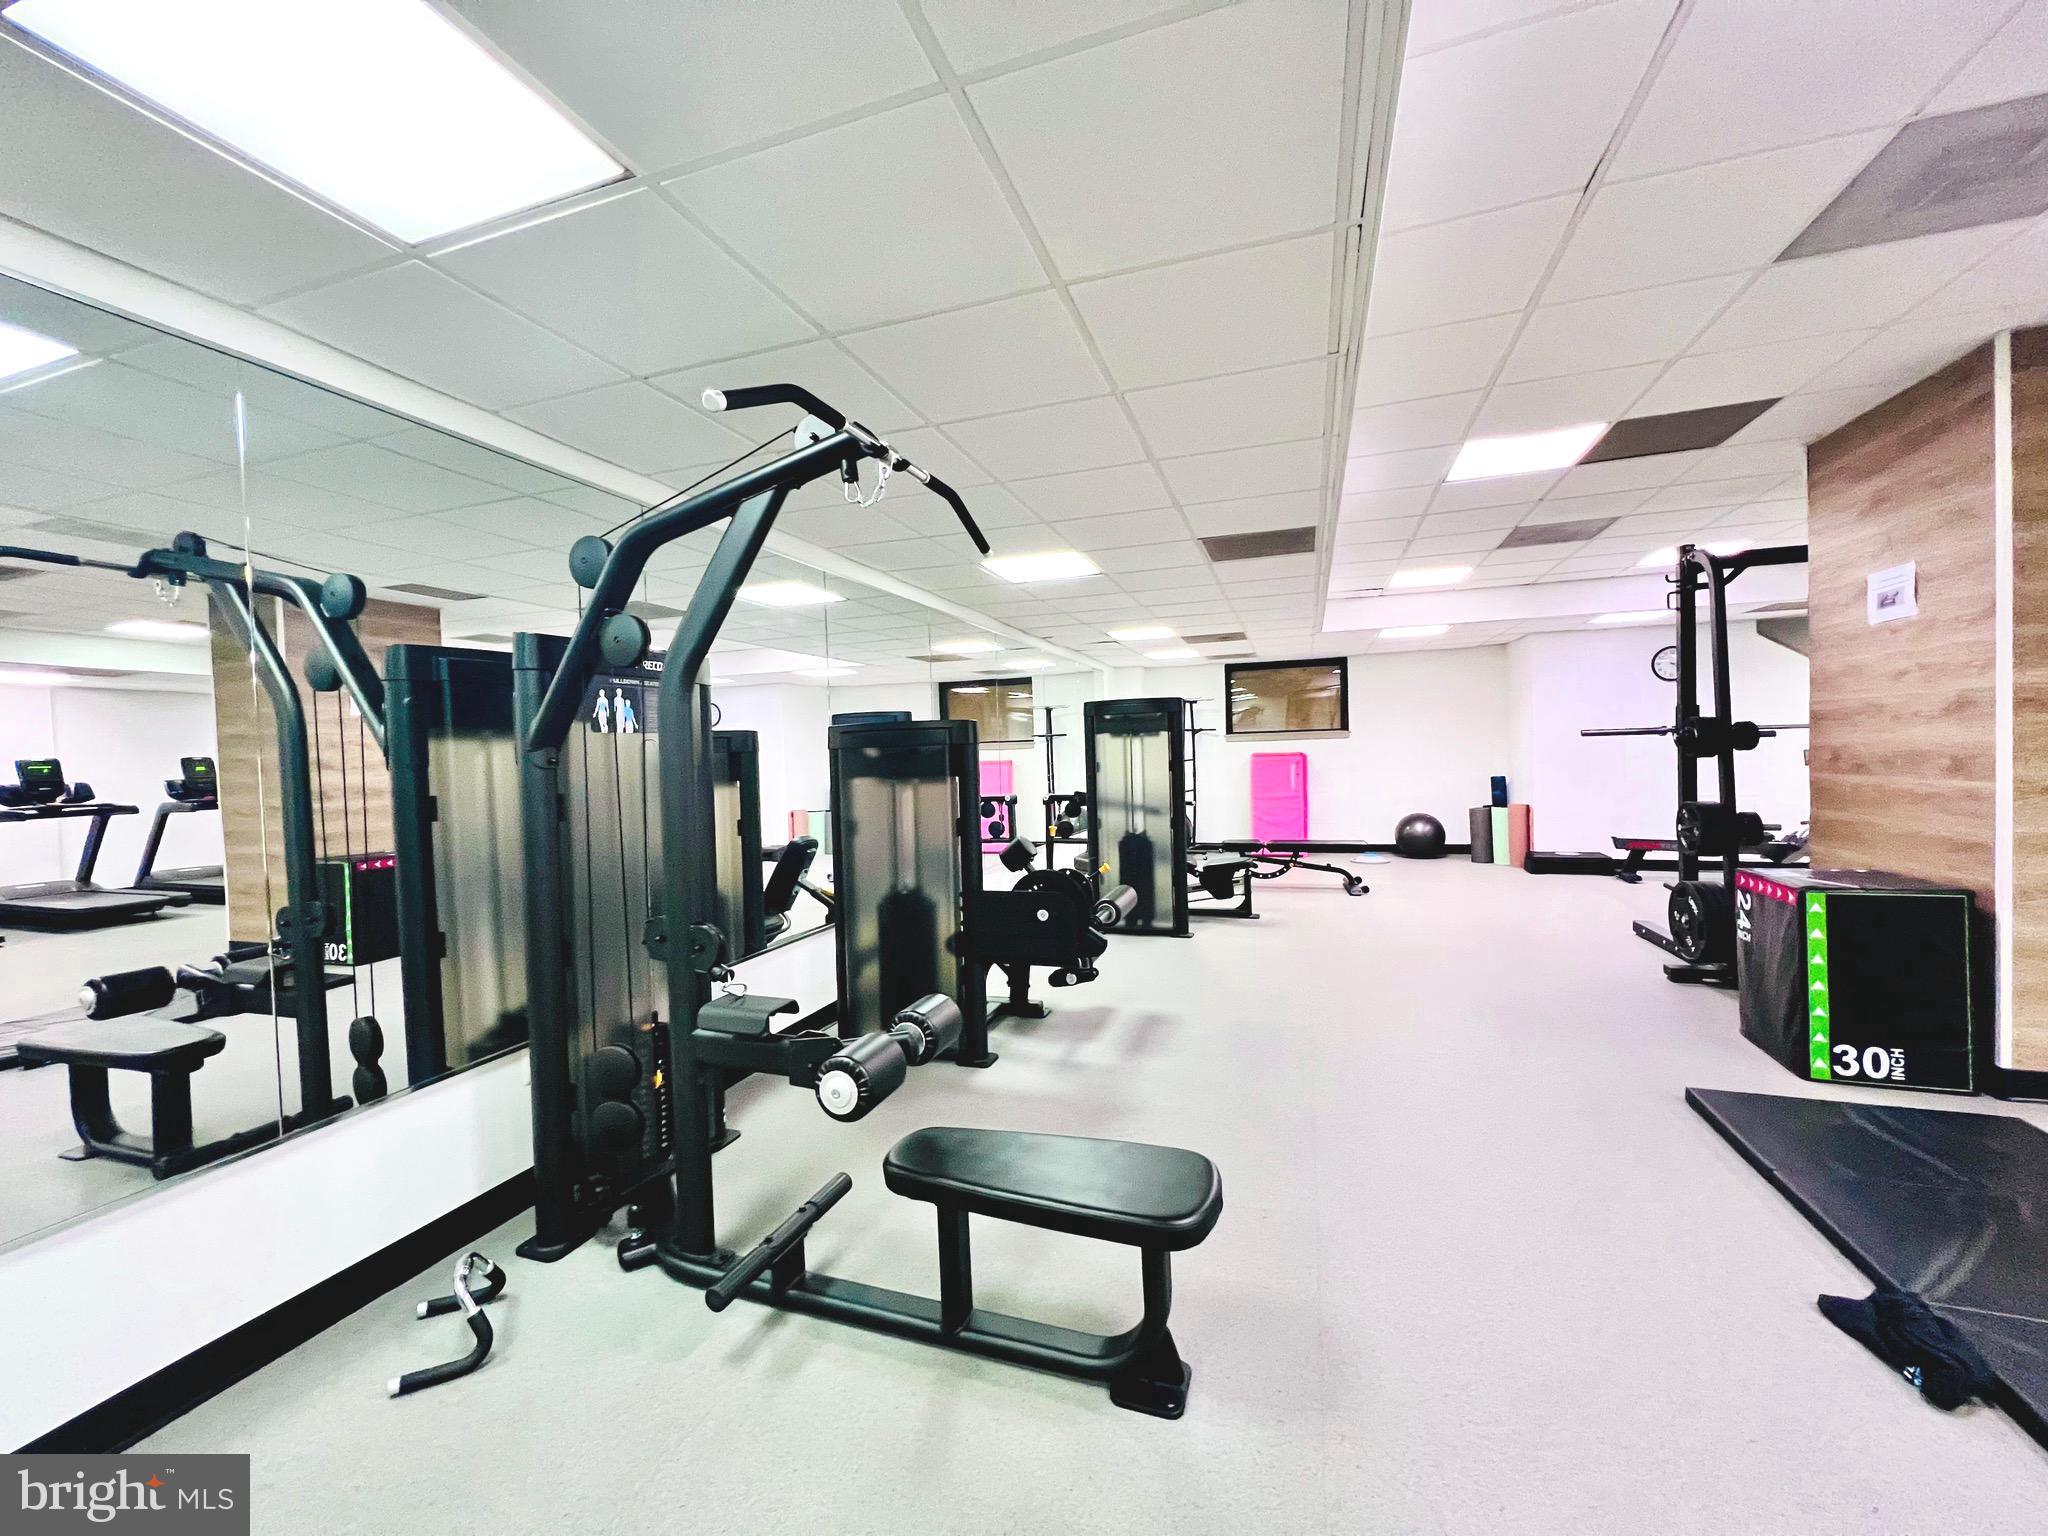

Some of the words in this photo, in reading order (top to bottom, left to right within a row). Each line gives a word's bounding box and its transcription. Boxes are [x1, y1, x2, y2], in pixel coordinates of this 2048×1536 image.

[1737, 889, 1752, 930] 24
[1832, 1044, 1890, 1079] 30
[1890, 1048, 1906, 1081] INCH
